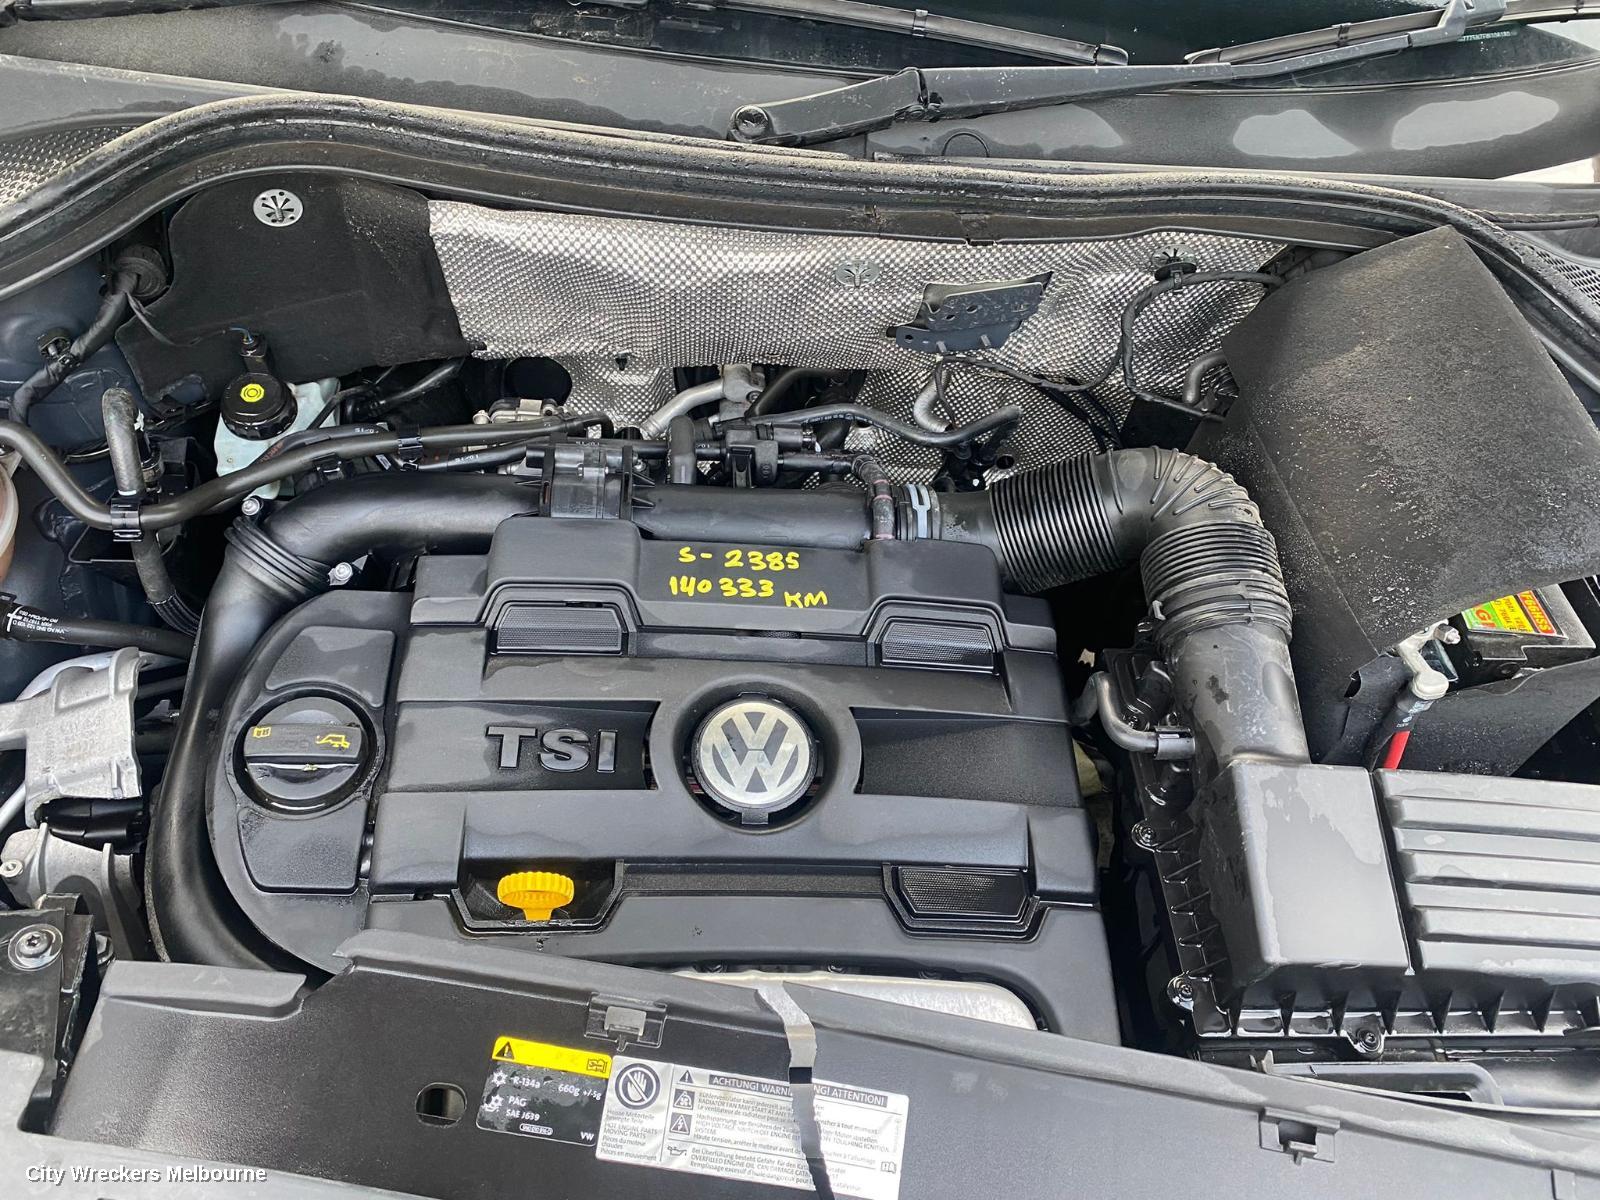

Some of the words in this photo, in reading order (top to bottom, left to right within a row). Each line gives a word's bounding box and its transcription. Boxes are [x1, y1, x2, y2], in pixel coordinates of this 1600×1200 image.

[724, 549, 800, 571] 2385
[783, 590, 828, 609] KM
[486, 726, 618, 774] TSI
[508, 1095, 527, 1107] PAG
[712, 1077, 759, 1091] ACHTUNG!
[832, 1088, 885, 1106] ATTENTION!
[506, 1108, 520, 1118] SAE
[580, 1131, 595, 1141] VW
